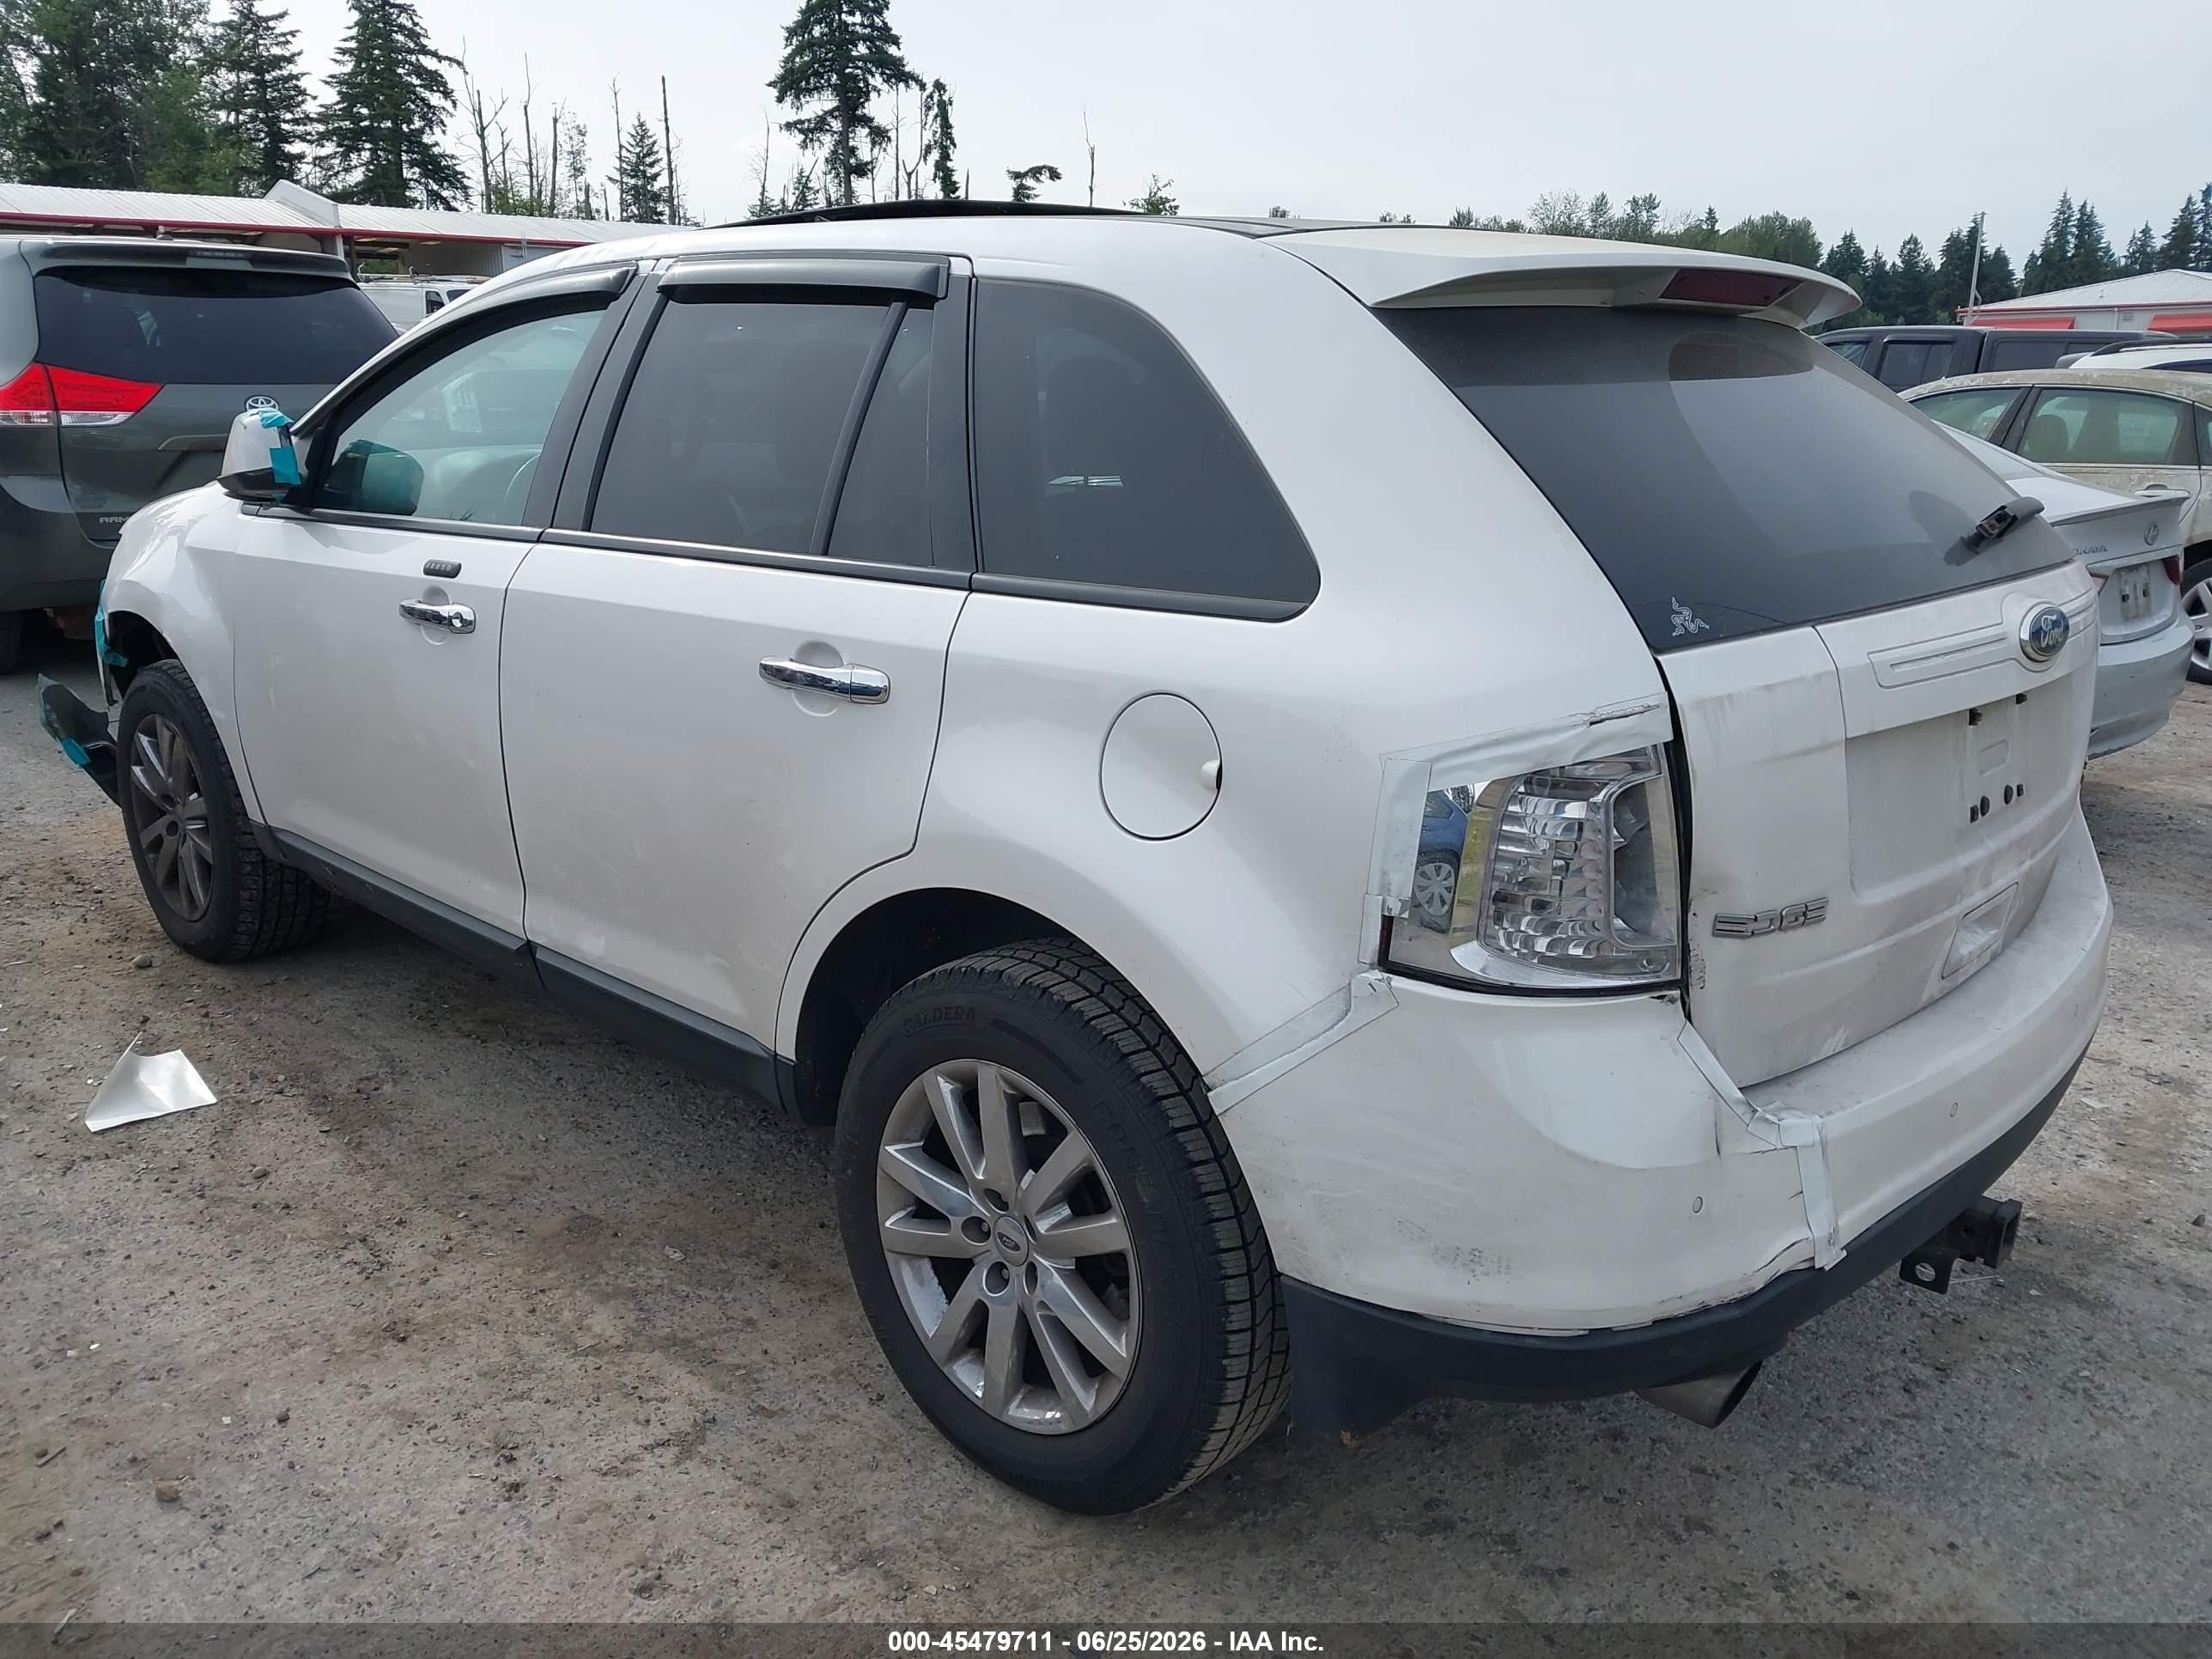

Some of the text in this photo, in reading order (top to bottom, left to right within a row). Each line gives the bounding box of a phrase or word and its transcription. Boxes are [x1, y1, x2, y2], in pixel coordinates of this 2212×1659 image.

[99, 515, 131, 525] RAM
[2075, 544, 2108, 556] ONATA
[2039, 613, 2064, 648] Ford
[1712, 896, 1830, 939] EDGE
